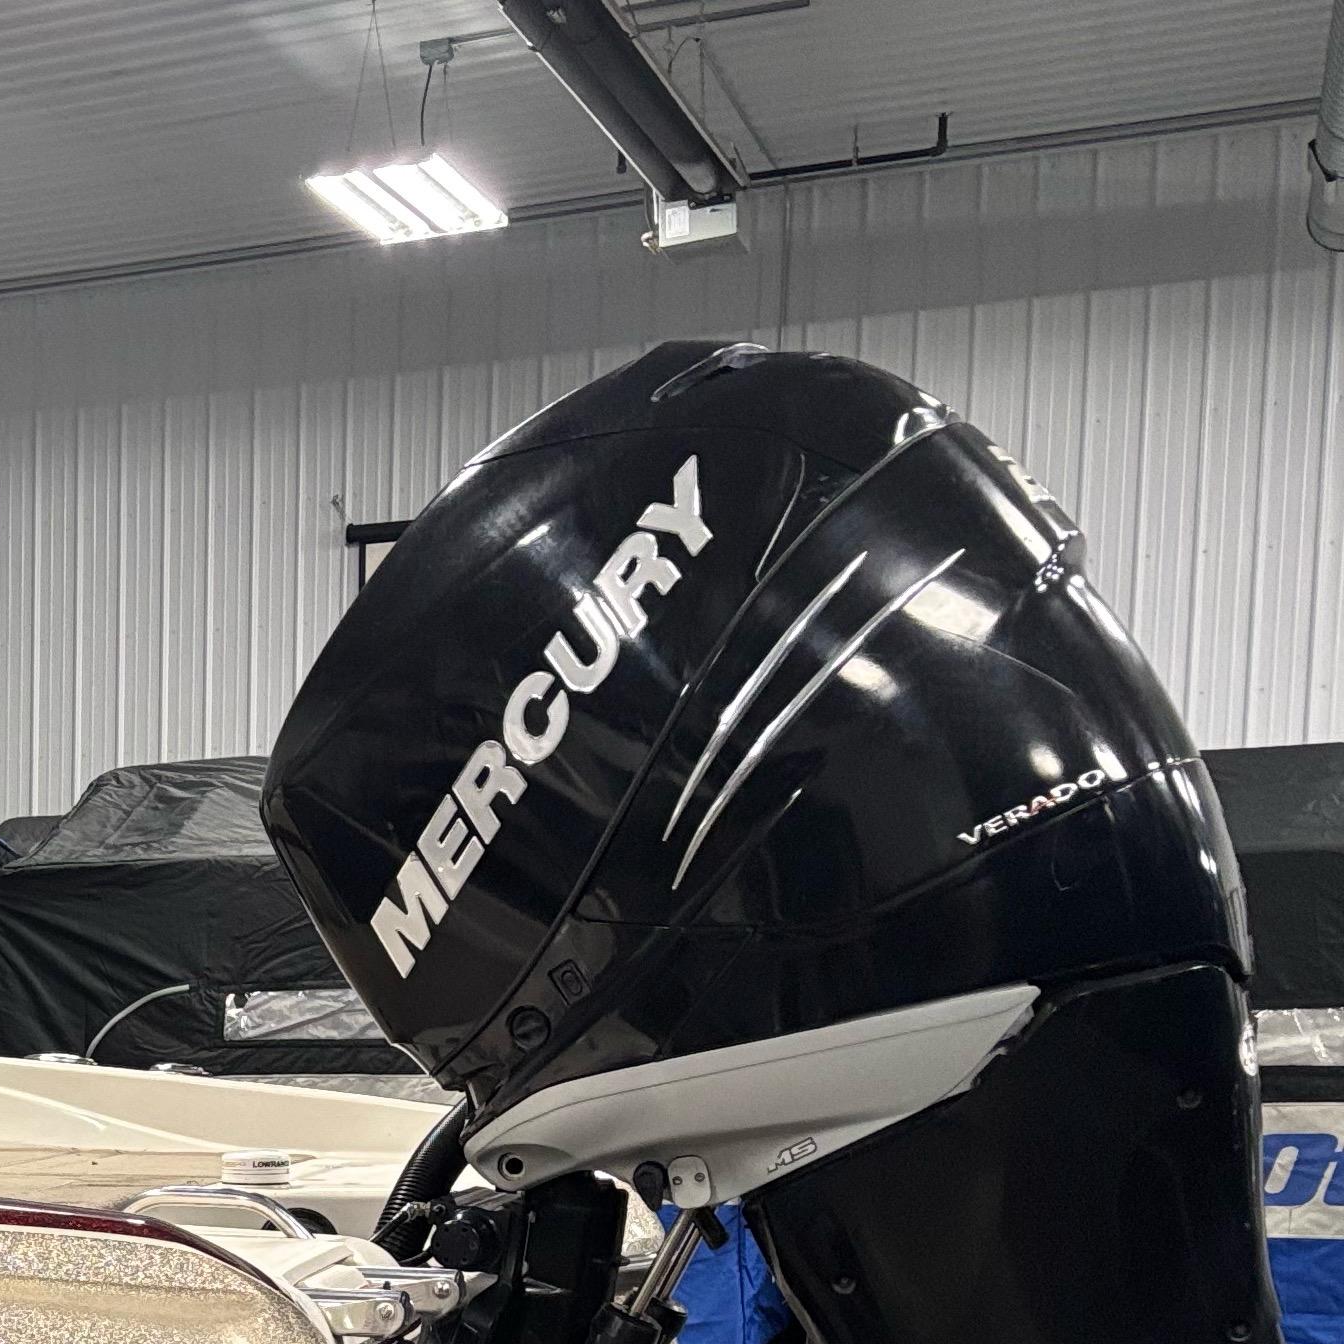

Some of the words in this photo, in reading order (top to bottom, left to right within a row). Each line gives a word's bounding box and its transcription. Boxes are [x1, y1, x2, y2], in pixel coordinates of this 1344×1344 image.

[370, 454, 714, 978] MERCURY
[956, 769, 1106, 845] VERADO
[253, 1160, 290, 1168] LOWRANC
